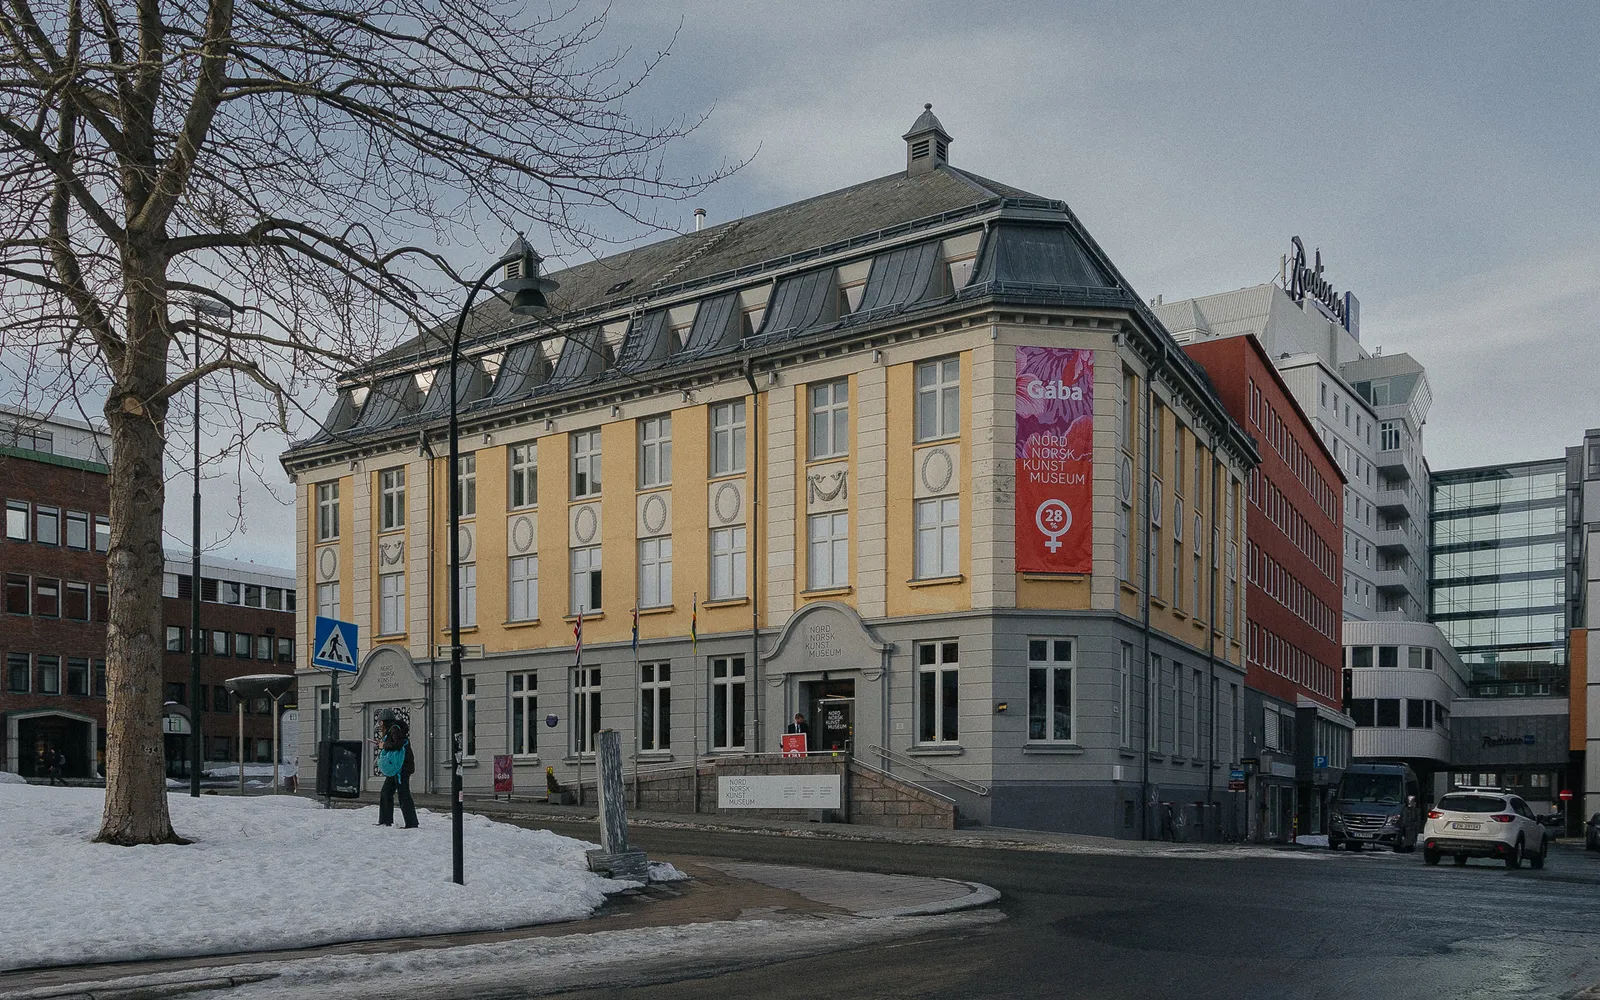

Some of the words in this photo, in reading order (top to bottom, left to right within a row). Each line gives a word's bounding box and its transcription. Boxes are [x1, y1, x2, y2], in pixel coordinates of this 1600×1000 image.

[1027, 380, 1083, 400] Gába
[1032, 435, 1068, 447] NORD
[1032, 447, 1075, 460] NORSK
[1023, 459, 1066, 471] KUNST
[1030, 472, 1085, 485] MUSEUM
[1045, 509, 1063, 522] 28
[810, 625, 831, 633] NORD
[810, 633, 836, 642] NORSK
[805, 642, 829, 650] KUNST
[809, 649, 842, 658] MUSEUM
[1317, 757, 1325, 766] P
[729, 798, 755, 806] MUSEUM
